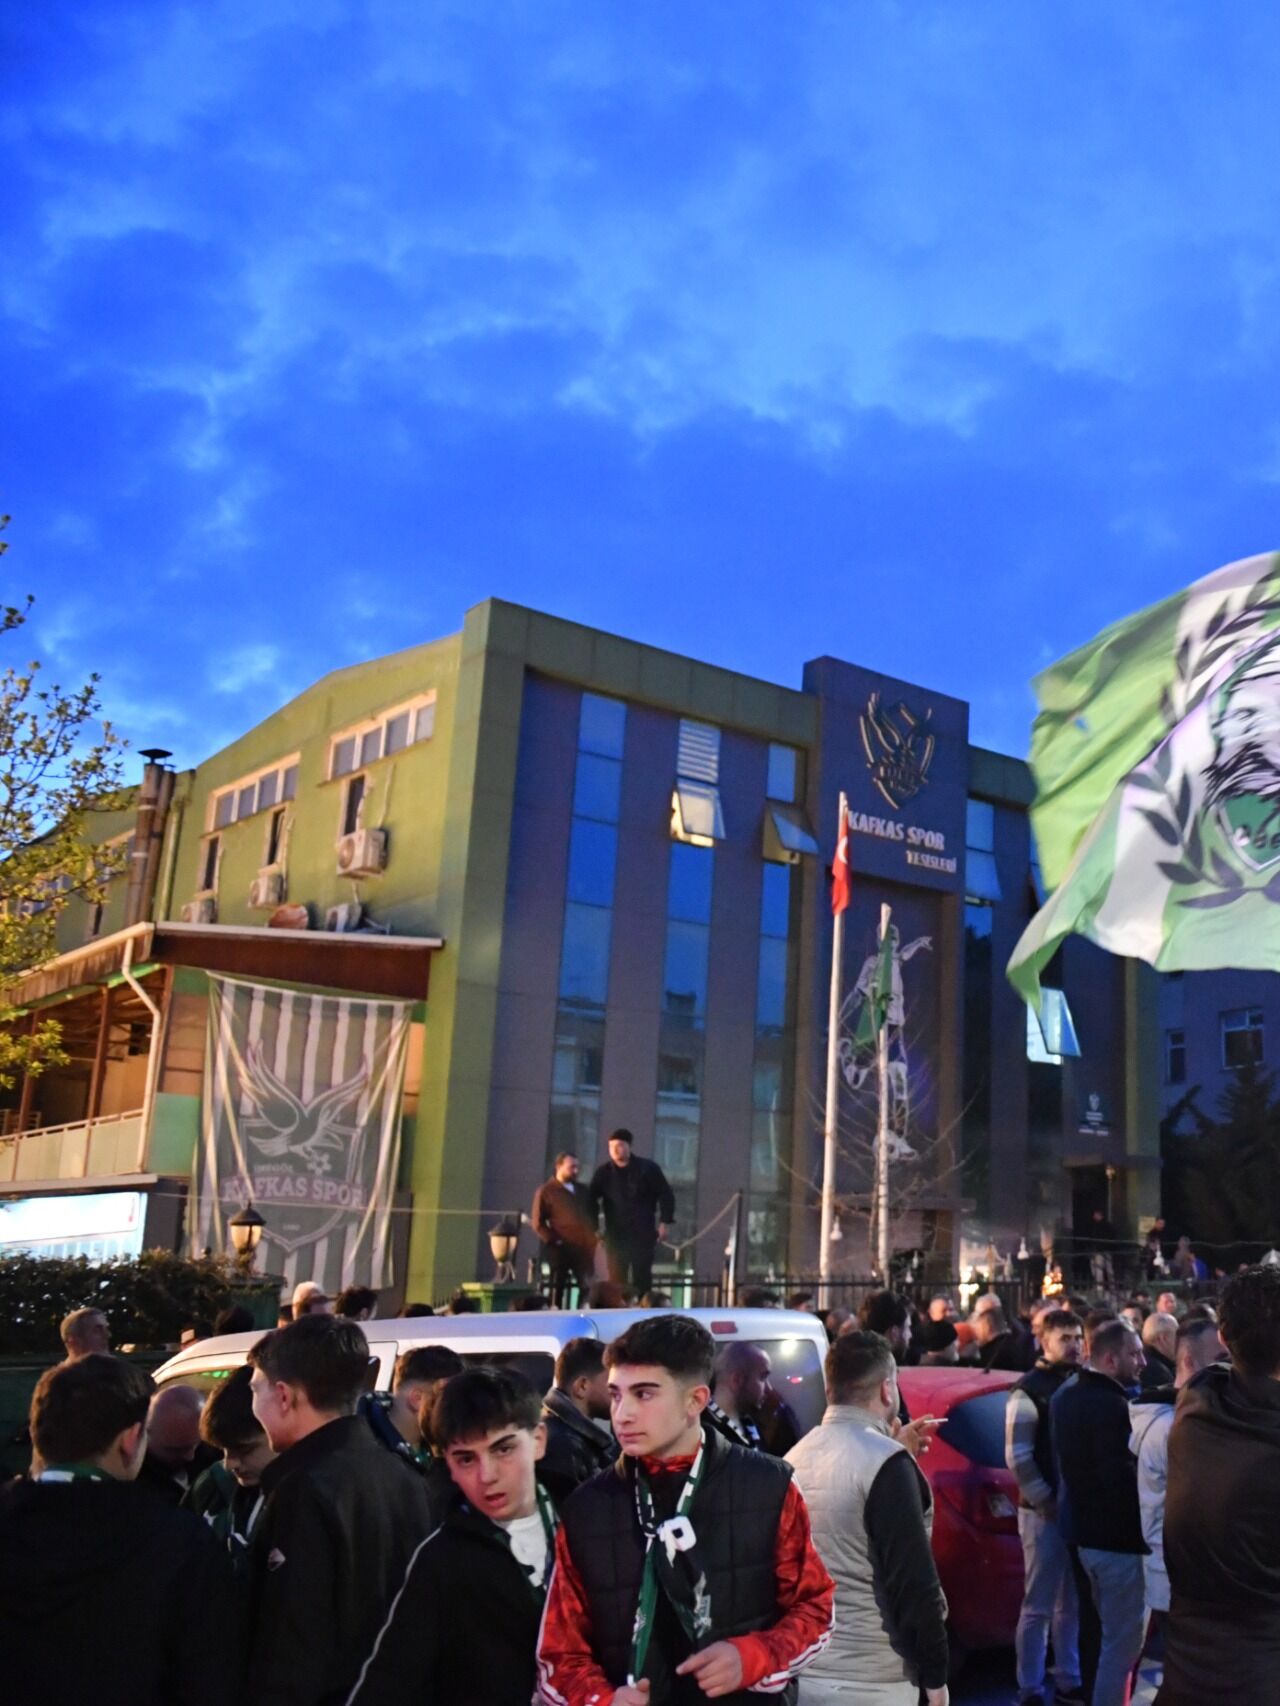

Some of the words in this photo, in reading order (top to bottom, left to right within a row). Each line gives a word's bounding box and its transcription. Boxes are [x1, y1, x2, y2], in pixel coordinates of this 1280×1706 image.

[849, 811, 904, 840] KAFKAS
[907, 826, 945, 851] SPOR
[312, 1179, 364, 1208] SPOR
